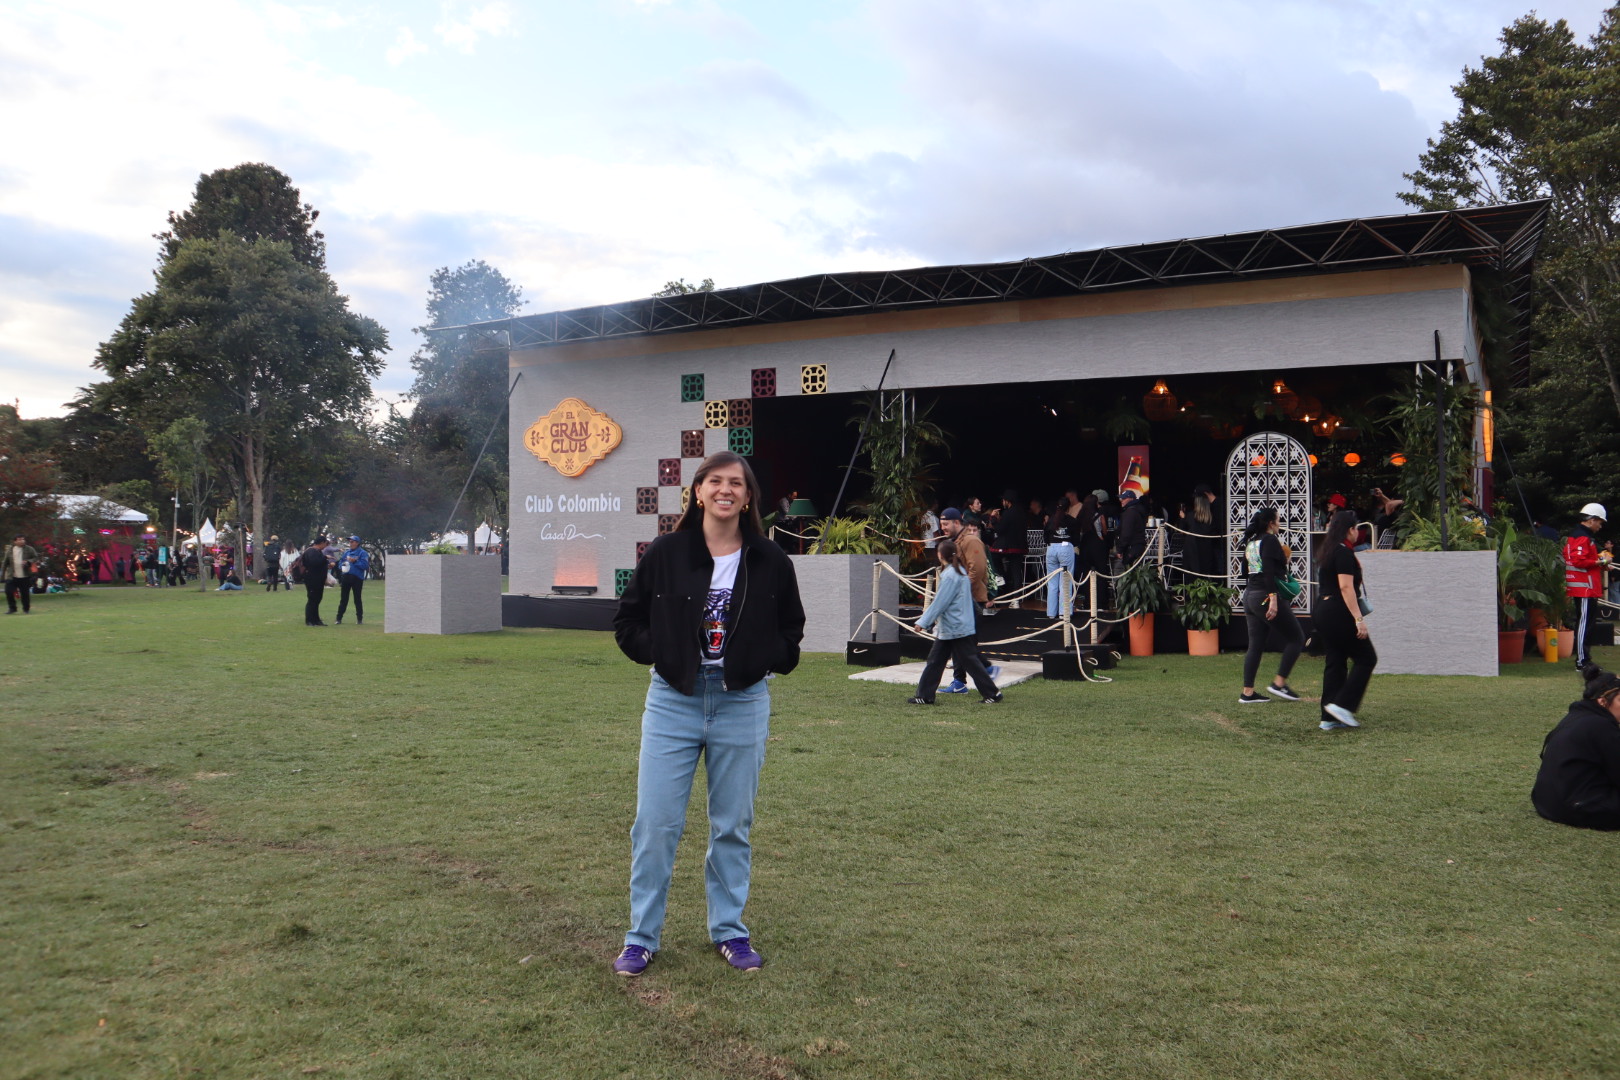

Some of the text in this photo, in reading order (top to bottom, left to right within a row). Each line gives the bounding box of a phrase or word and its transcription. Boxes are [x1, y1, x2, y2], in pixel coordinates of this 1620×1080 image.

[550, 421, 592, 441] GRAN
[551, 439, 587, 453] CLUB
[525, 492, 621, 513] Club Colombia
